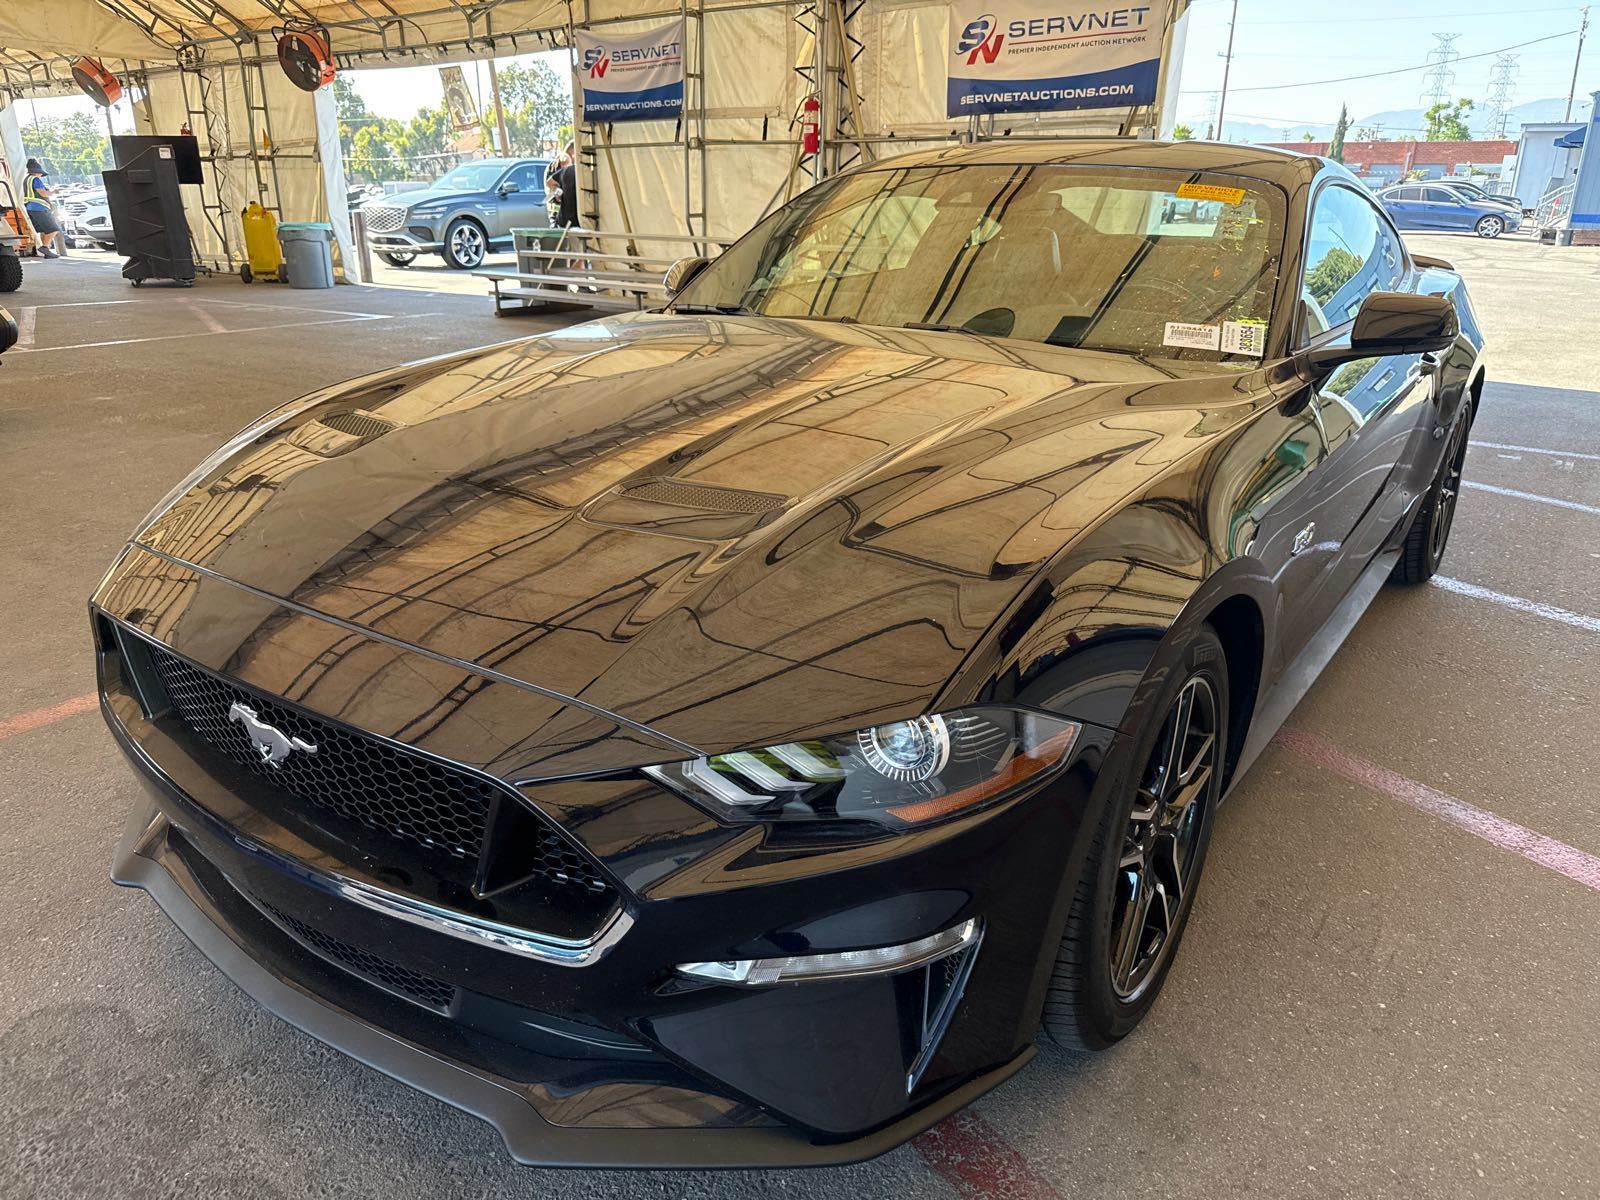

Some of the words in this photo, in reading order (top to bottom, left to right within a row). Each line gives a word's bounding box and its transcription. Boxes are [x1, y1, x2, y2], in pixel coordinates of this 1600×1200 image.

[1008, 8, 1150, 38] SERVNET
[611, 43, 680, 62] SERVNET
[1008, 46, 1035, 55] PREMIER
[1035, 43, 1080, 53] INDEPENDENT
[1080, 38, 1111, 48] AUCTION
[1112, 35, 1147, 46] NETWORK
[586, 98, 682, 112] SERVNETAUCTIONS.COM
[960, 85, 1134, 105] SERVNETAUCTIONS.COM
